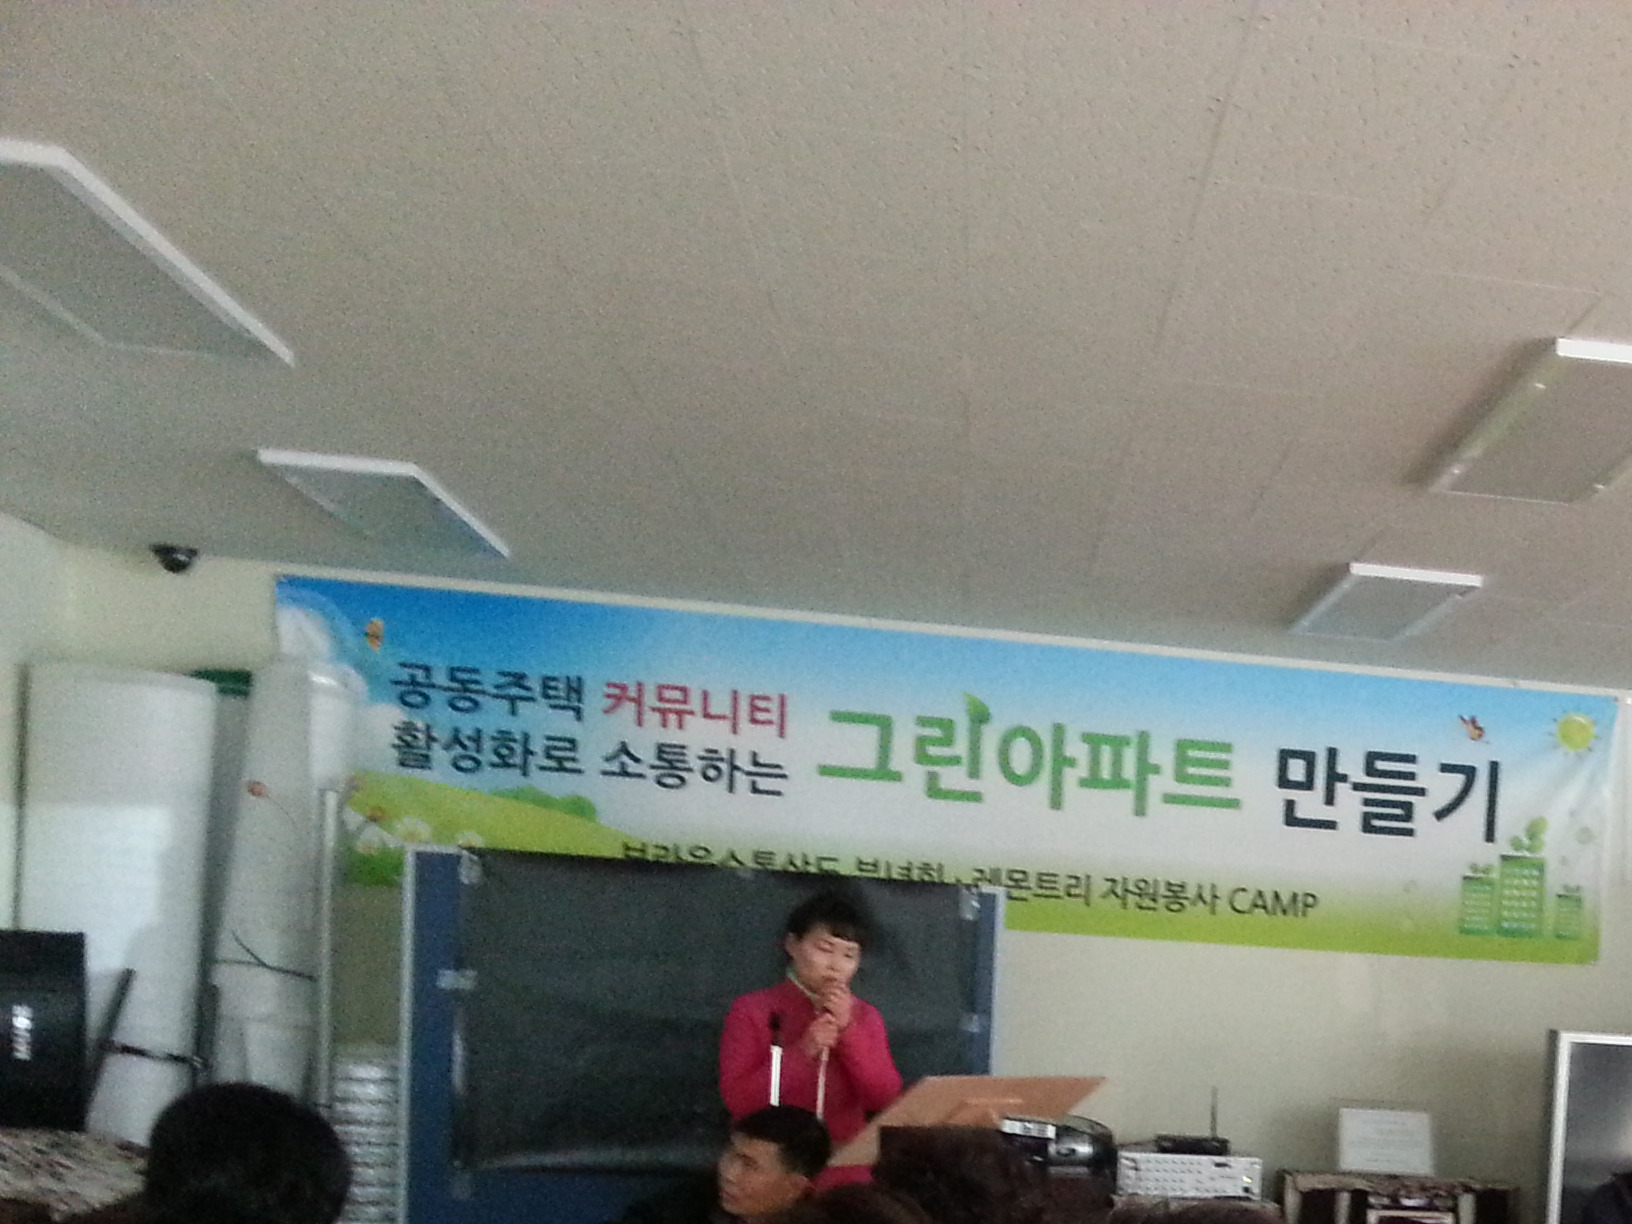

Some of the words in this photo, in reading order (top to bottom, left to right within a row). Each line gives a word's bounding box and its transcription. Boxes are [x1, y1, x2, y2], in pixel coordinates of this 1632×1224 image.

[390, 661, 584, 720] 공동주택
[602, 679, 787, 739] 커뮤니티
[391, 719, 585, 777] 활성화로
[600, 738, 788, 797] 소통하는
[818, 692, 1241, 817] 그린아파트
[1277, 745, 1500, 844] 만들기
[1103, 876, 1221, 915] 자원봉사
[1228, 886, 1320, 918] CAMP
